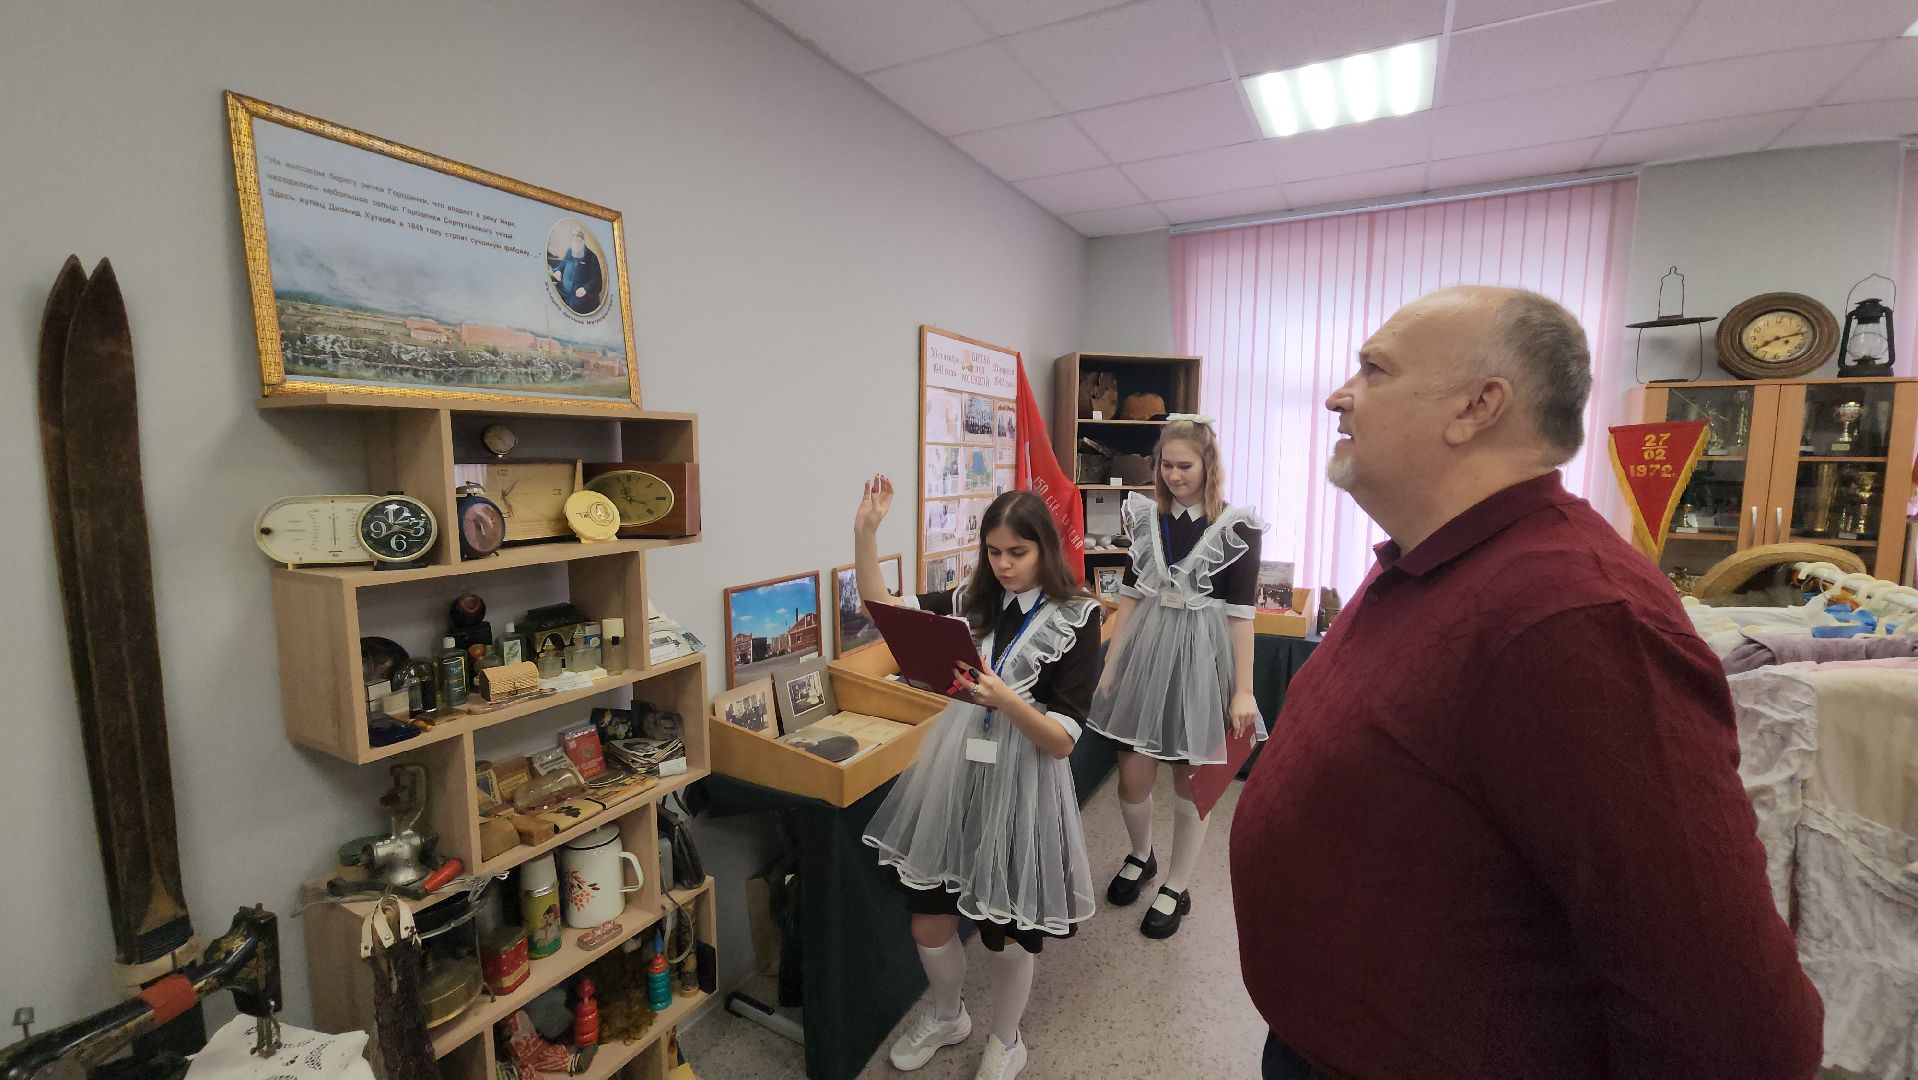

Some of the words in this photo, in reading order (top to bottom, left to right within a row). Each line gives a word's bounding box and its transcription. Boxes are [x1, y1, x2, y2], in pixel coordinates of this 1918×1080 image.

[329, 172, 357, 187] берегу
[447, 205, 473, 216] впадает
[266, 173, 319, 191] находилось
[323, 187, 369, 204] небольшое
[443, 217, 493, 235] Серпуховского
[268, 188, 296, 201] Здесь
[299, 197, 326, 210] купец
[328, 203, 362, 217] Диомид
[444, 232, 468, 242] строит
[971, 352, 991, 365] БИТВА
[1644, 433, 1671, 447] 27
[1643, 449, 1667, 461] 02
[384, 503, 411, 524] 12
[370, 521, 387, 539] 9
[409, 519, 425, 537] 3
[390, 534, 407, 551] 6
